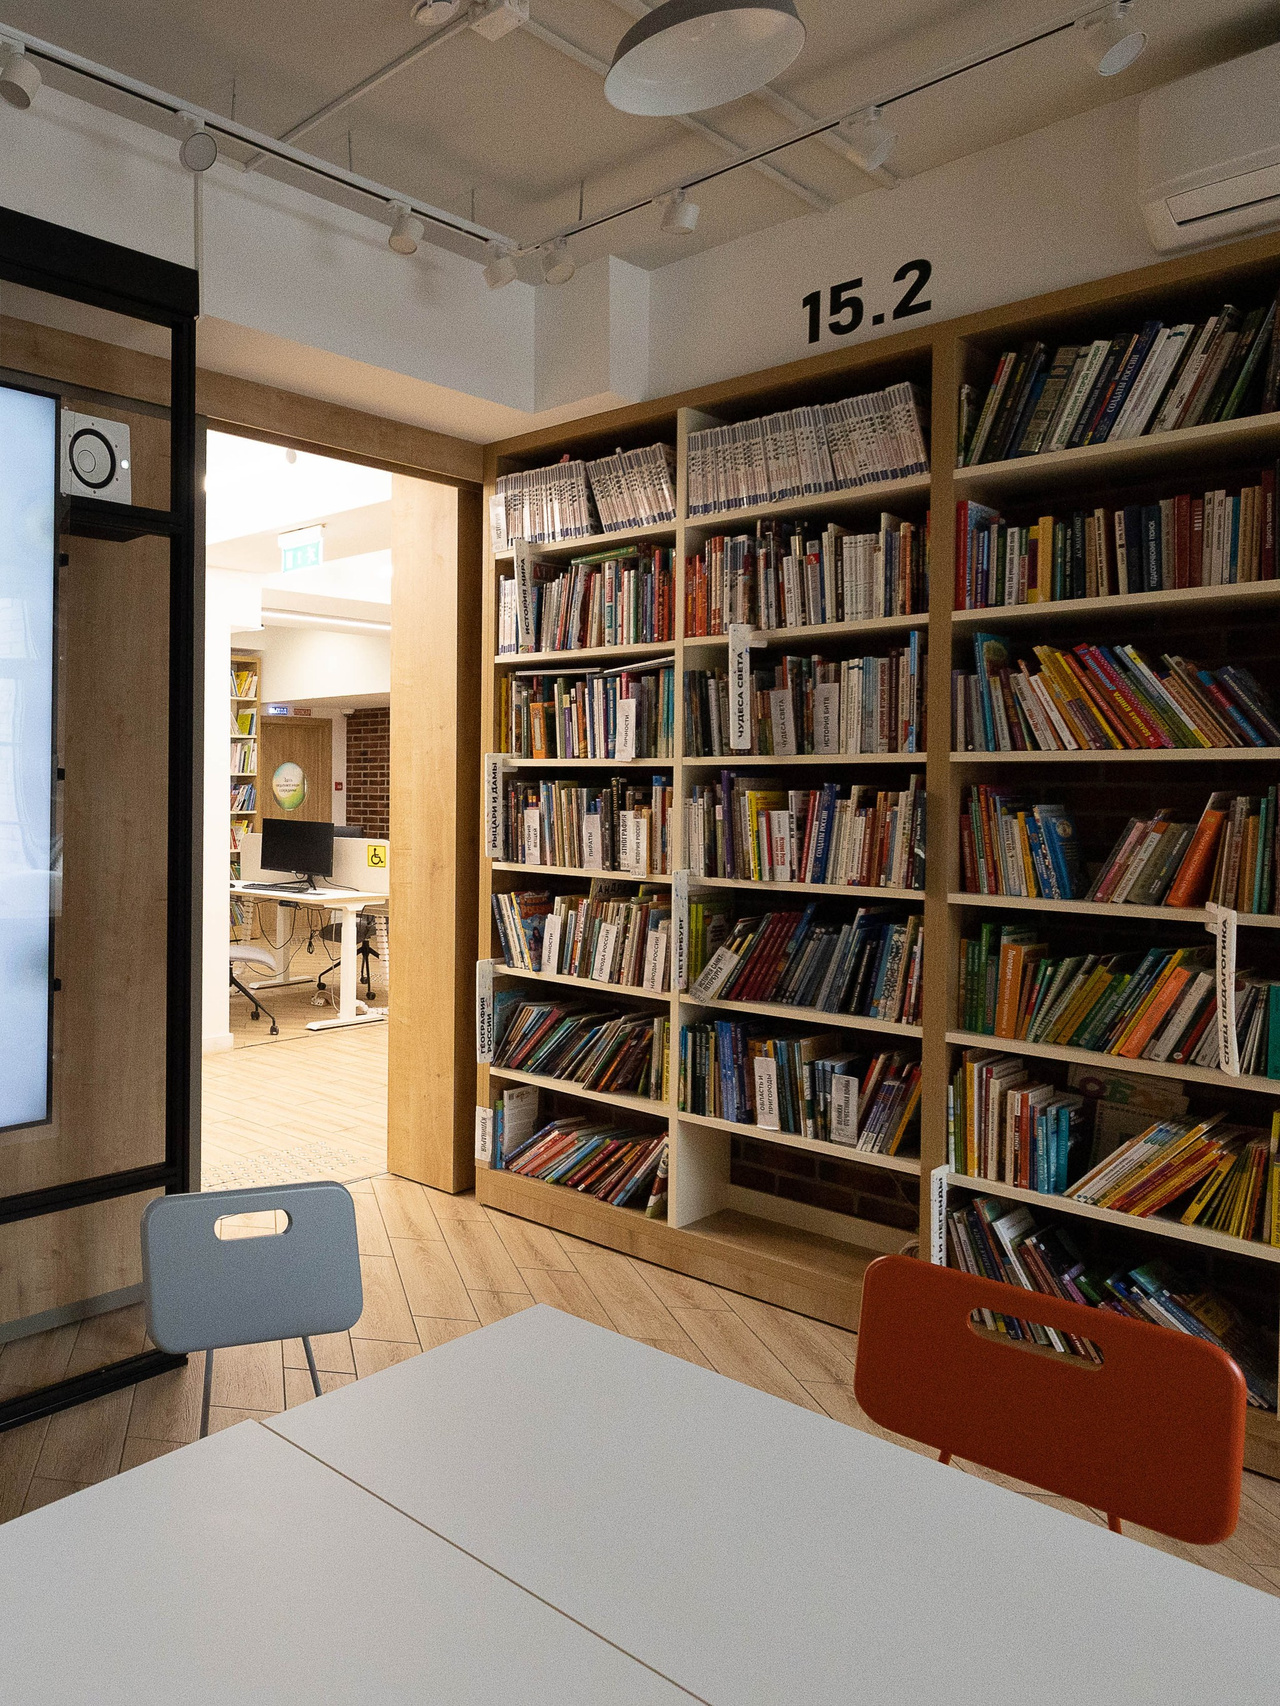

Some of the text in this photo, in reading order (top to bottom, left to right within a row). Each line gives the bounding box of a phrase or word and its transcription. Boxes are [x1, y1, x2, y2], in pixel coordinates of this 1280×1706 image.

[803, 259, 932, 343] 15.2
[519, 558, 530, 635] ИСТОРИЯ МИРА
[598, 929, 610, 977] ГОРОДА РОССИИ
[698, 968, 713, 988] ИСТОРИЯ
[1221, 918, 1230, 1064] СПЕЦ ПЕДАГОГИКА
